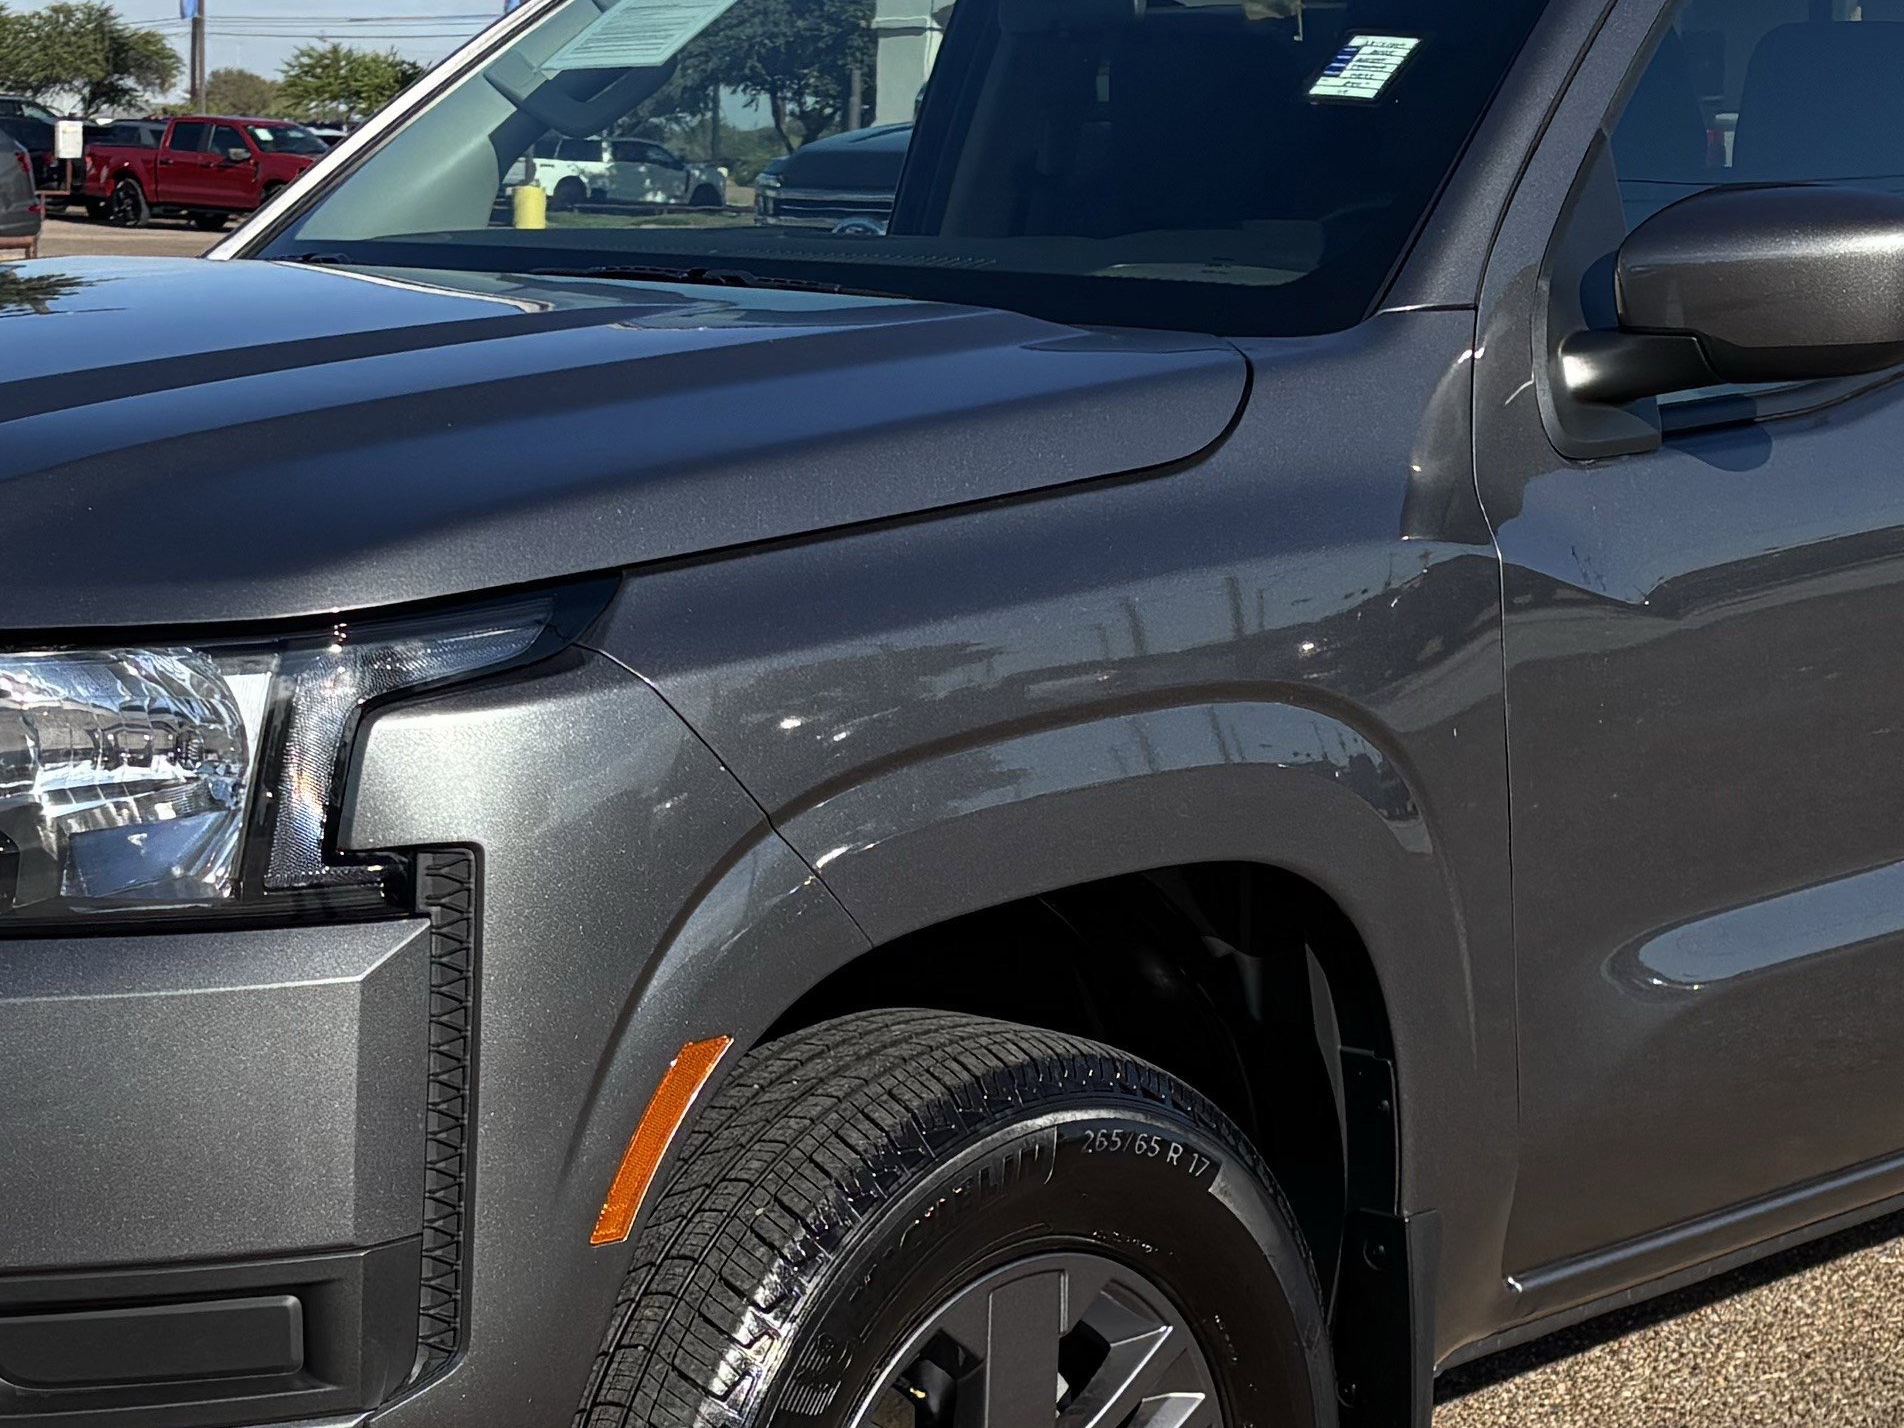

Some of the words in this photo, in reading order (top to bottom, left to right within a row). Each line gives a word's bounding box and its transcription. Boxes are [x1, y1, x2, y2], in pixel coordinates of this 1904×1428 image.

[1081, 1128, 1162, 1158] 265/65
[1166, 1141, 1184, 1166] R
[1187, 1152, 1211, 1178] 17
